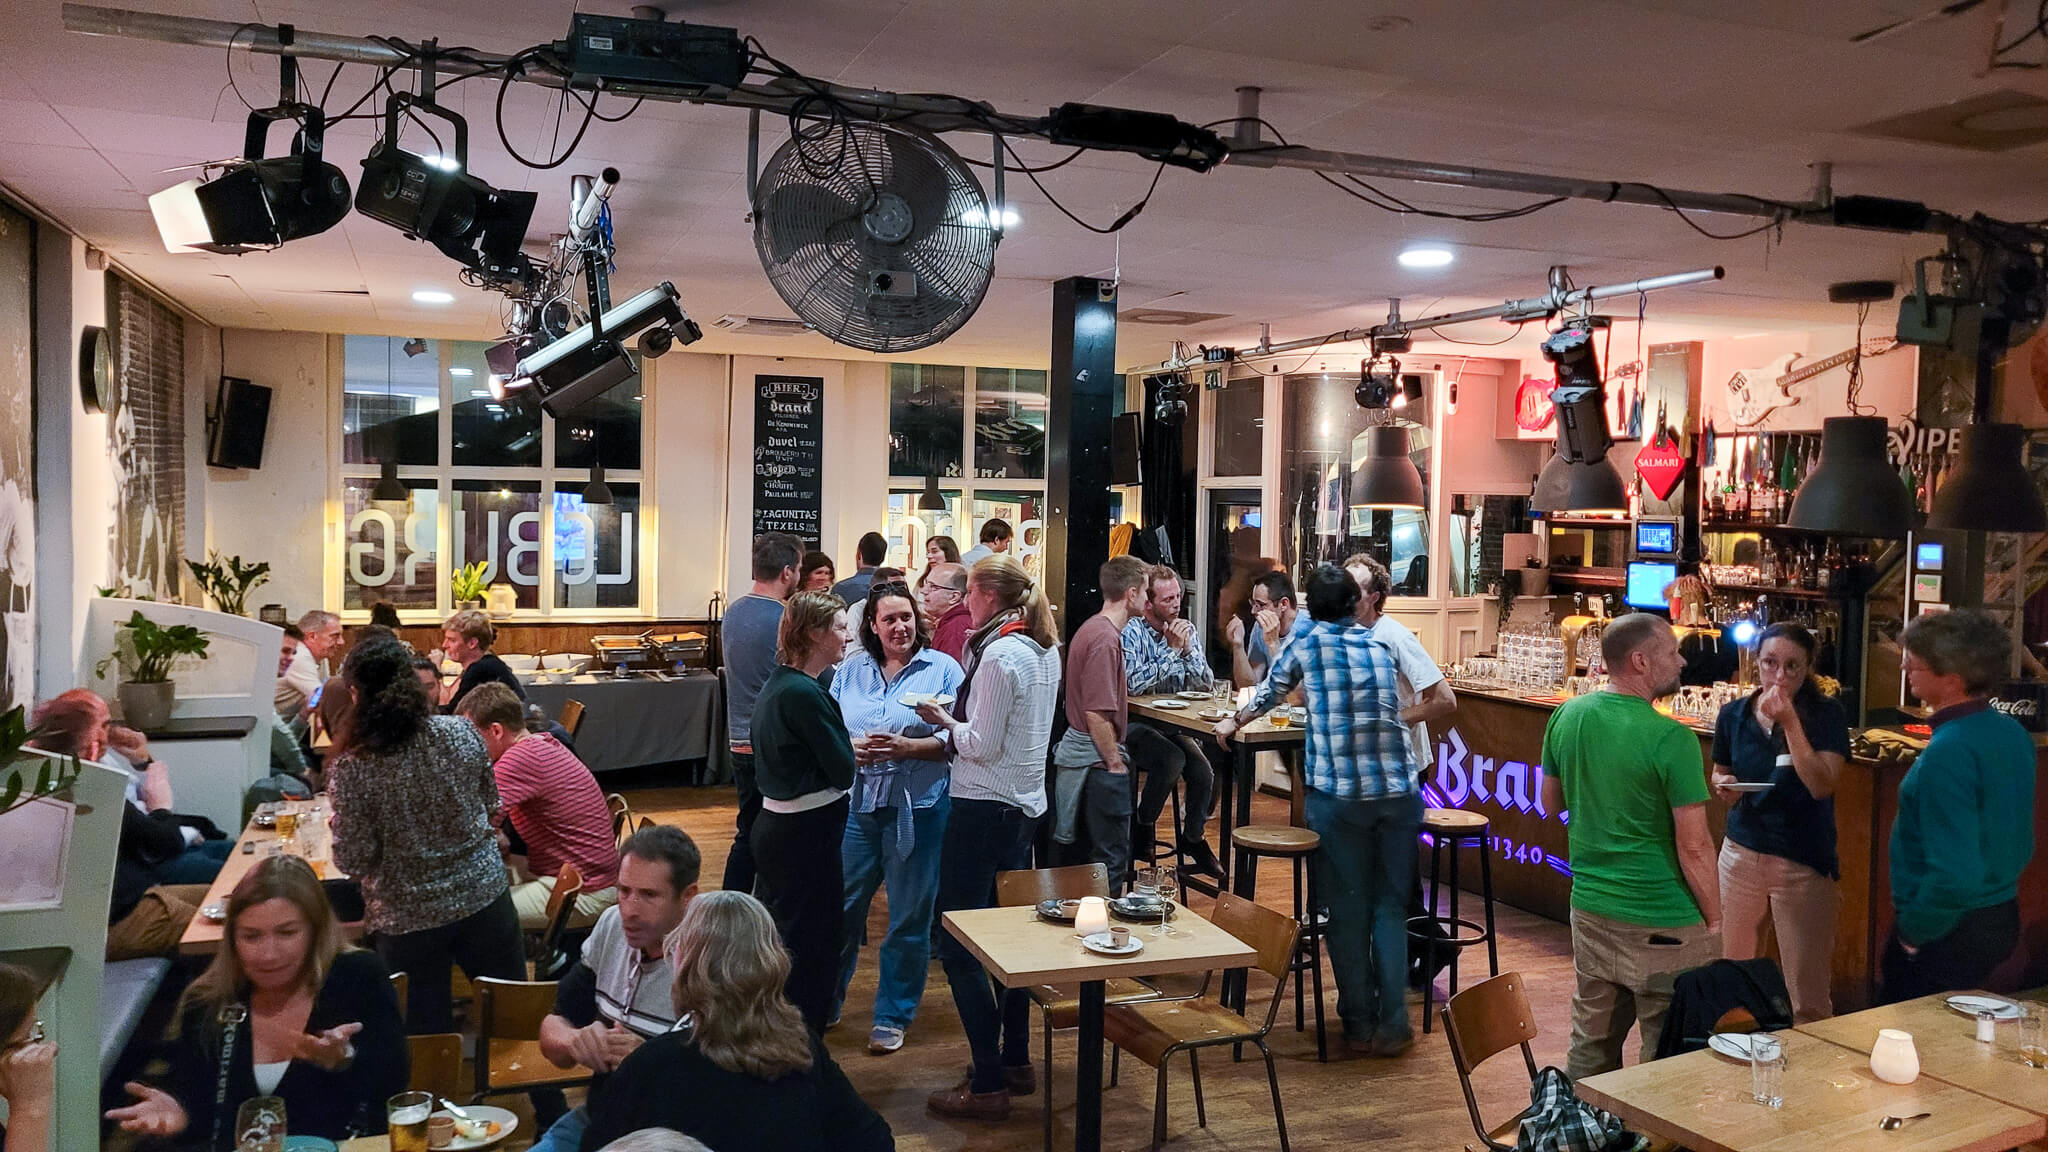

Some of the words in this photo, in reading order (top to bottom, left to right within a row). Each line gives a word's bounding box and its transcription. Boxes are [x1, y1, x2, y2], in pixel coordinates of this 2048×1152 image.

[1638, 458, 1679, 468] SALMARI
[763, 509, 817, 519] LAGUNITAS
[766, 521, 805, 531] TEXELS
[1492, 836, 1543, 864] 1340
